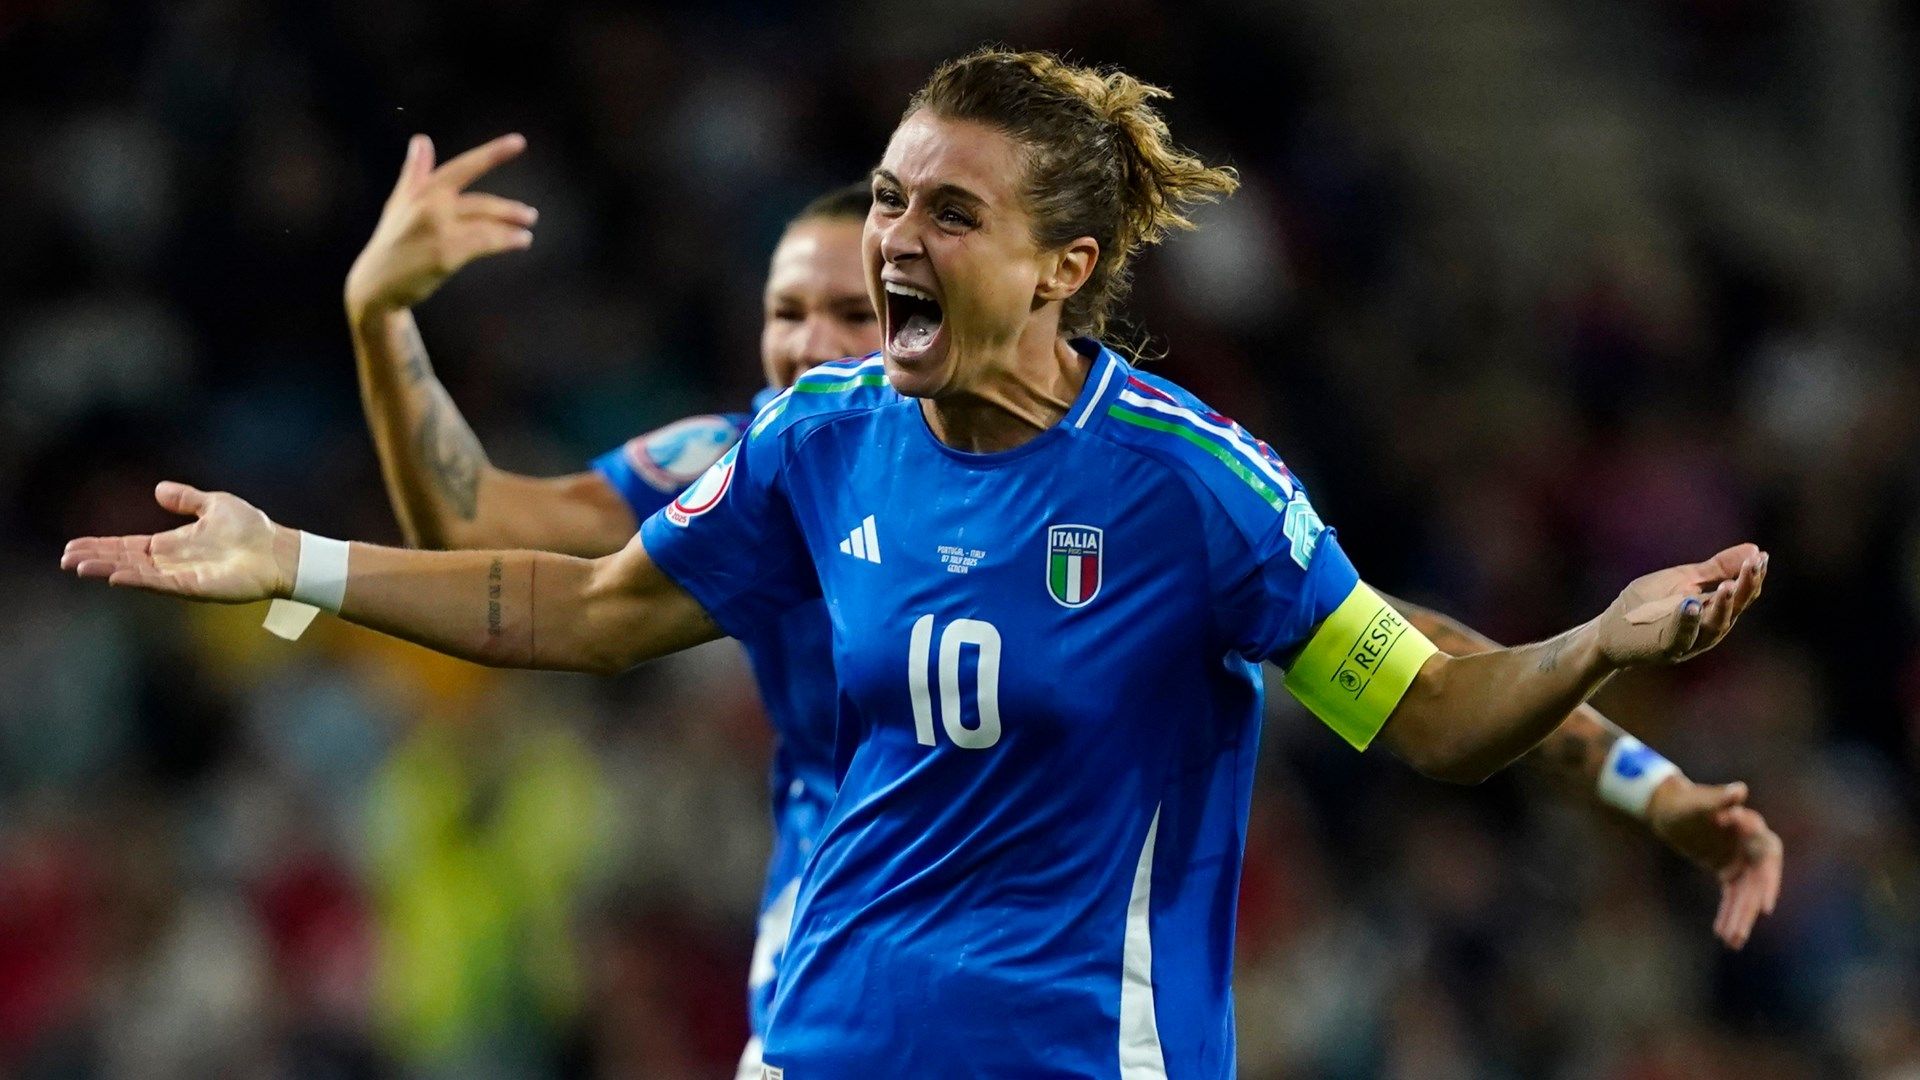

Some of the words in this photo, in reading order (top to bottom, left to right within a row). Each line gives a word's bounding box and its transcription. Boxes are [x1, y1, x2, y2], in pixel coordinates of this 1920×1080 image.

[671, 512, 687, 524] 2025
[1052, 531, 1097, 549] ITALIA
[908, 613, 1002, 749] 10
